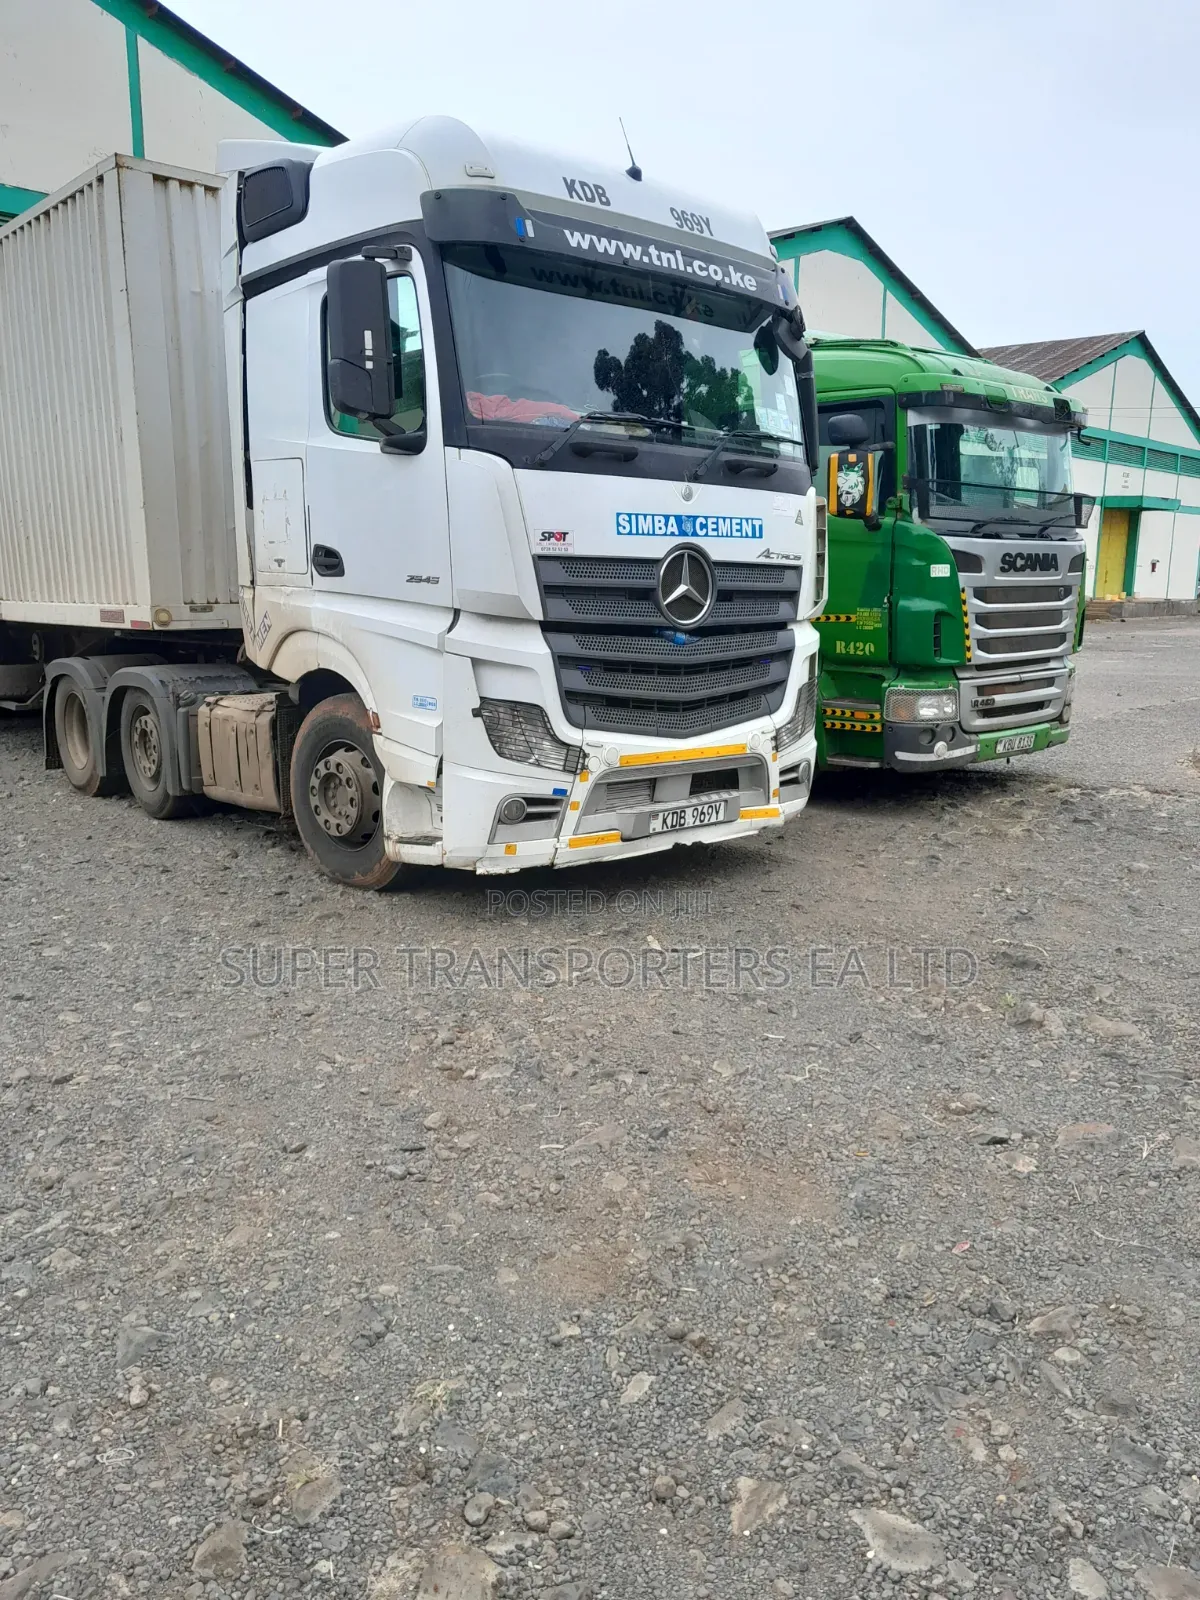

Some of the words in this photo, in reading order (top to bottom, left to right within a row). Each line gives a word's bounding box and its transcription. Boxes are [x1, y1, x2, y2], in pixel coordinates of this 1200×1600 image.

[562, 176, 611, 206] KDB
[669, 206, 714, 237] 969Y
[563, 229, 757, 291] www.tnl.co.ke
[617, 513, 680, 536] SIMBA
[695, 516, 763, 539] CEMENT
[1000, 552, 1059, 572] SCANIA
[835, 640, 875, 656] R420
[661, 809, 687, 830] KDB
[691, 793, 722, 825] 969Y
